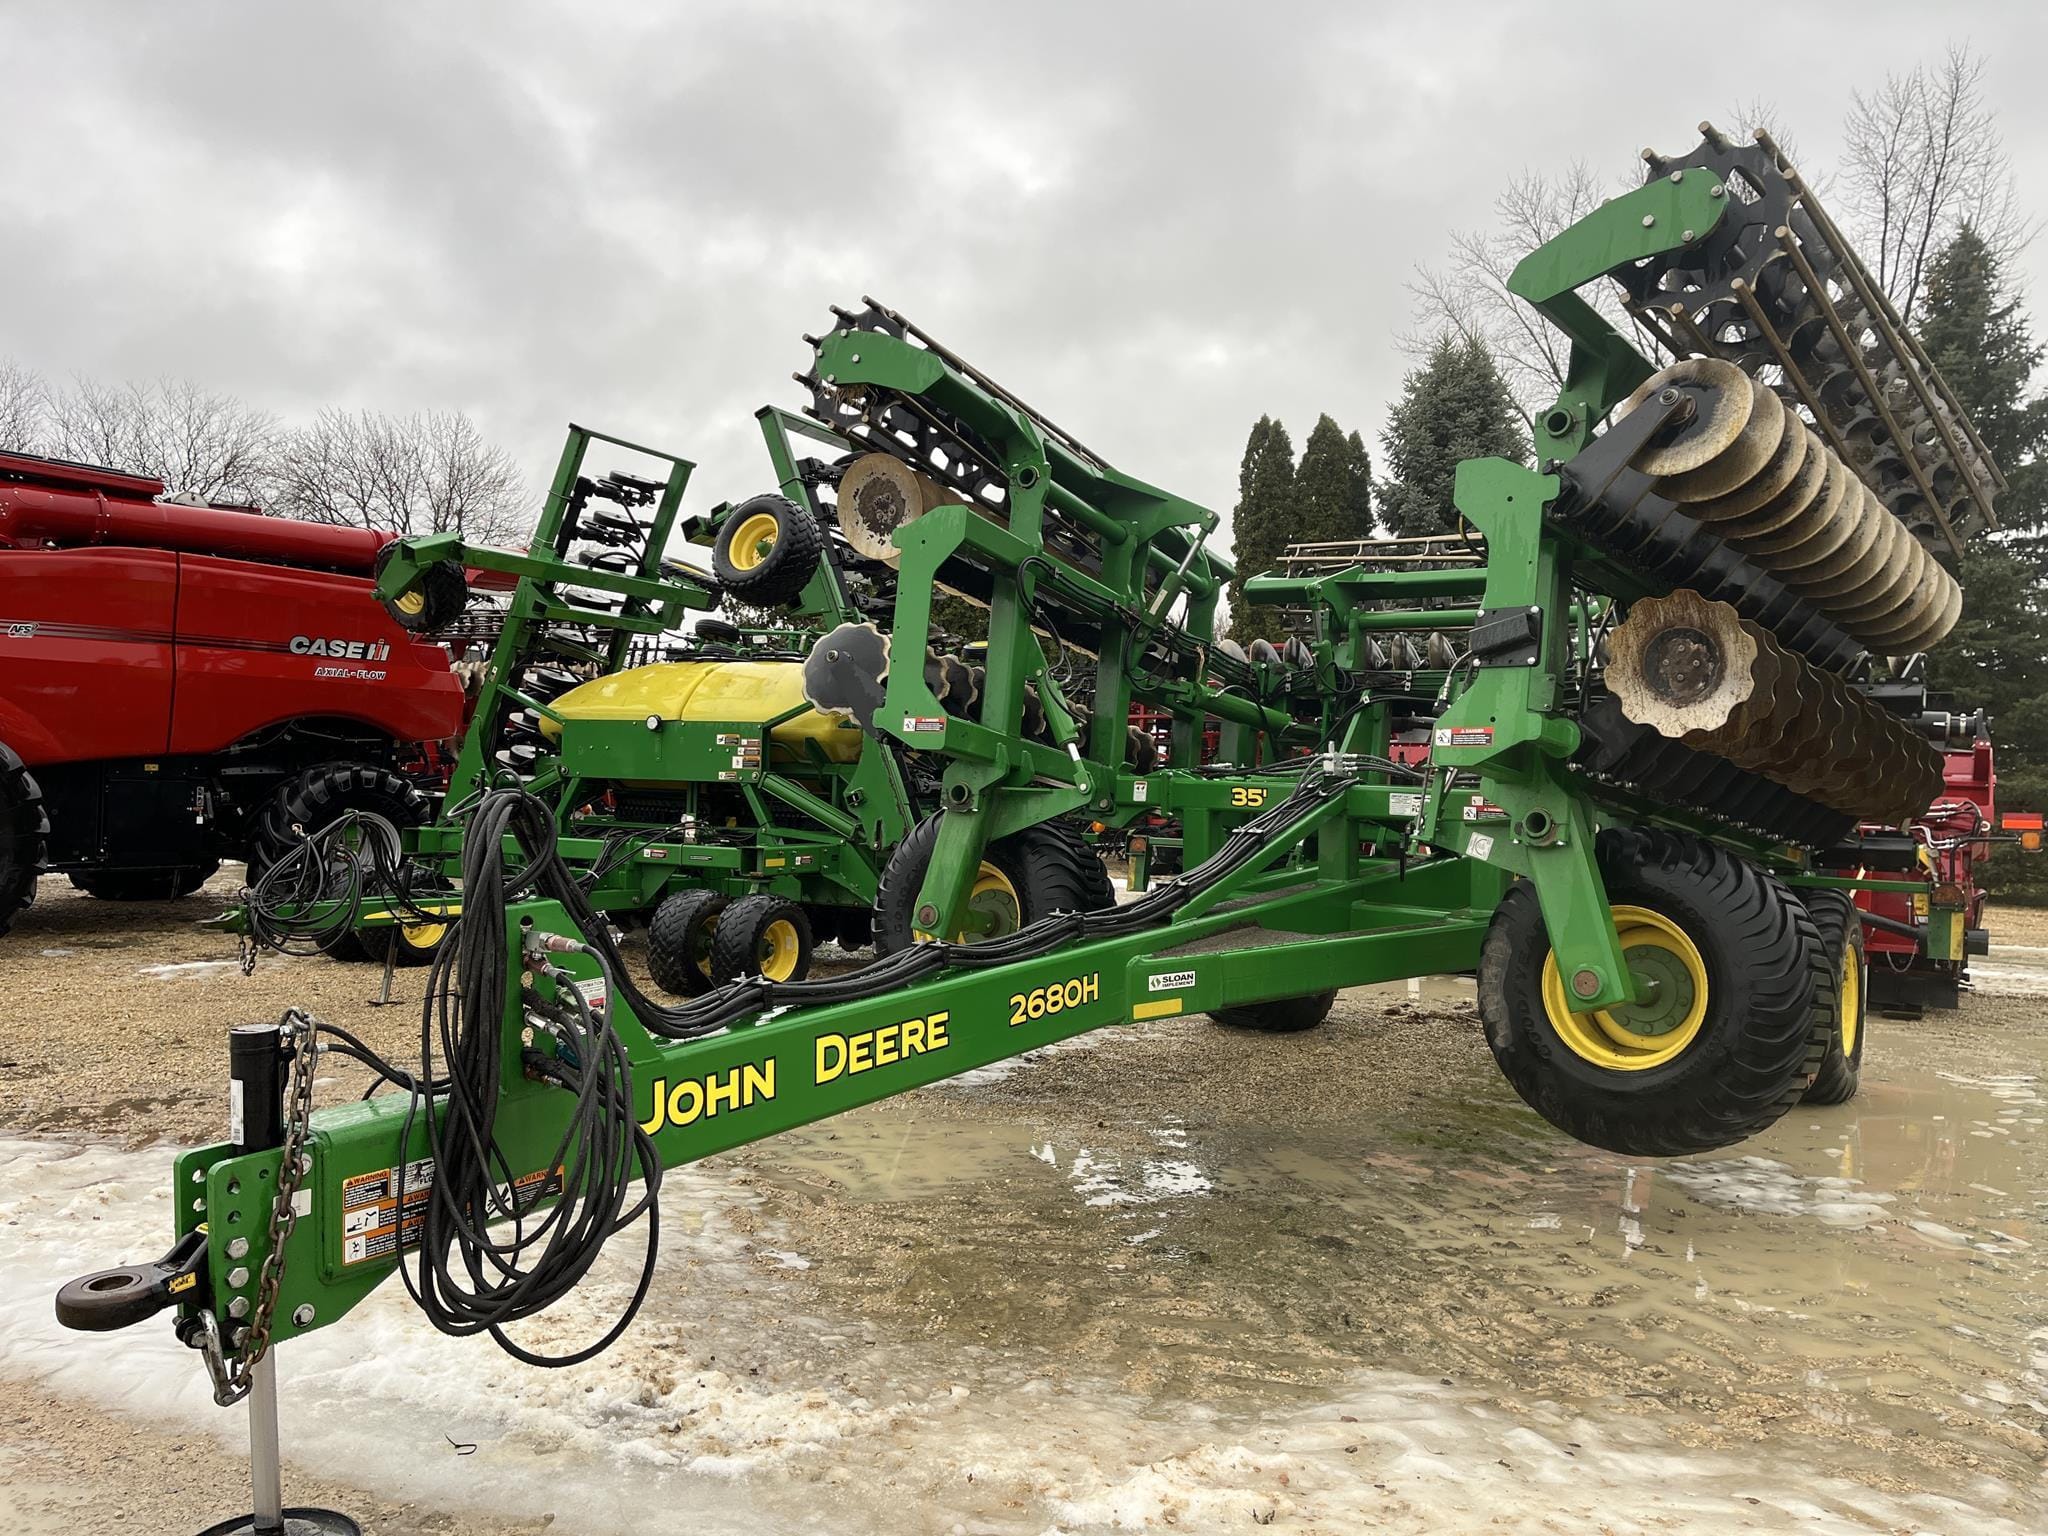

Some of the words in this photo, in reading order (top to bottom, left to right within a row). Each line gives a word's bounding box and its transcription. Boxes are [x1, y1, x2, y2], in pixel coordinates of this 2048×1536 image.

[289, 635, 365, 659] CASE
[314, 666, 387, 680] AXIAL-FLOW
[1162, 973, 1194, 983] SLOAN
[1162, 980, 1193, 988] IMPLEMENT
[1009, 972, 1099, 1026] 2680H
[638, 1056, 776, 1136] JOHN
[815, 1010, 949, 1086] DEERE
[353, 1171, 388, 1185] WARNING
